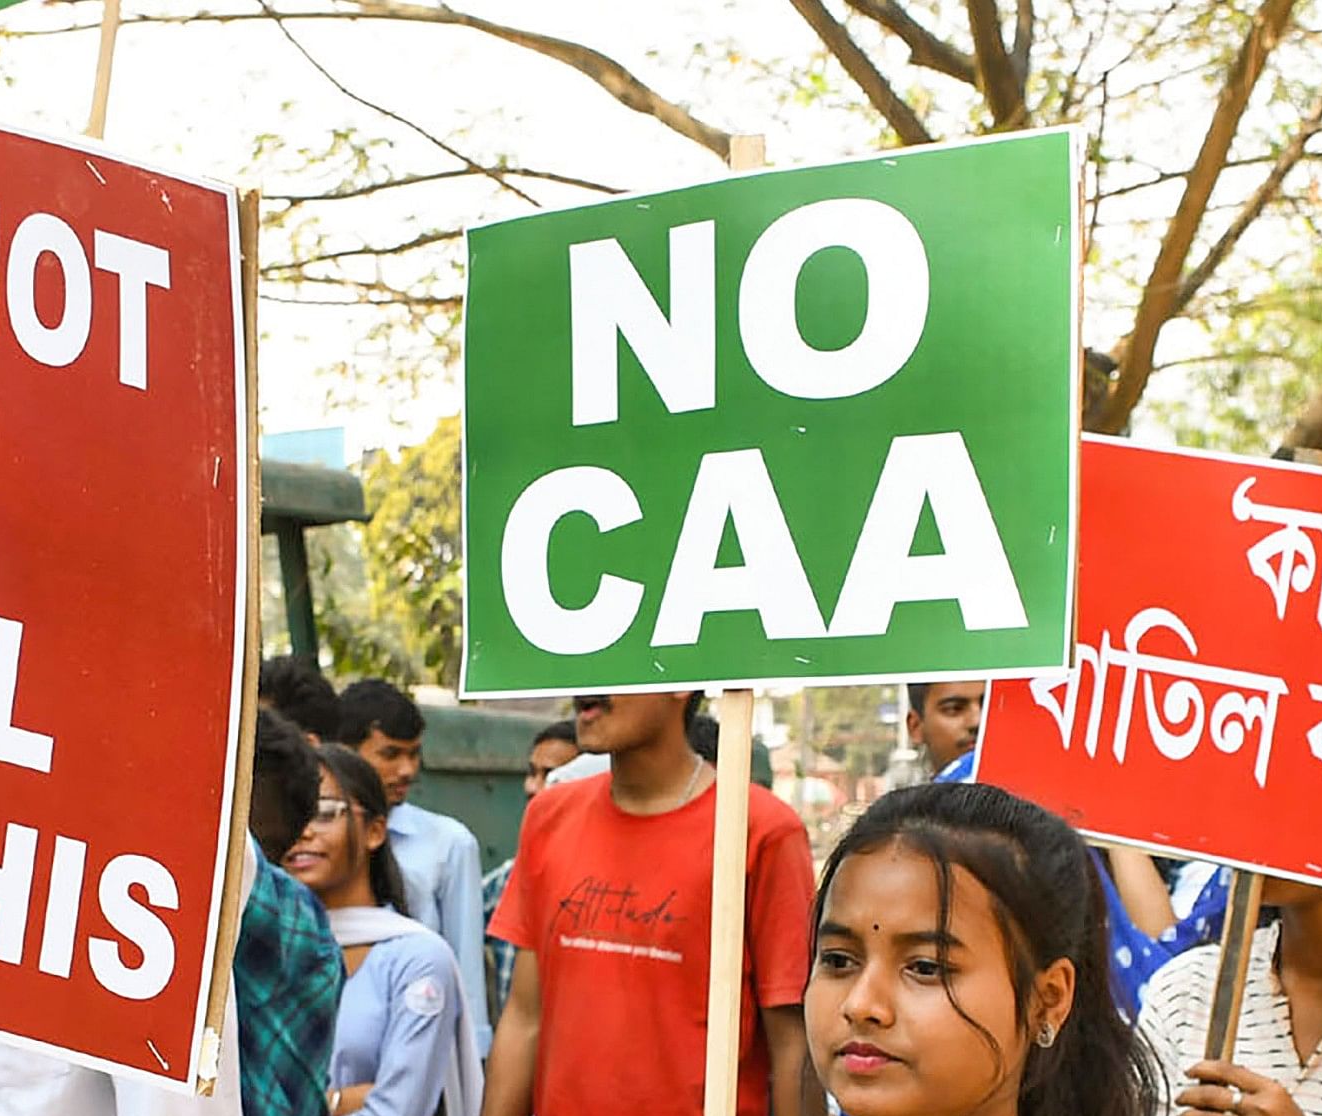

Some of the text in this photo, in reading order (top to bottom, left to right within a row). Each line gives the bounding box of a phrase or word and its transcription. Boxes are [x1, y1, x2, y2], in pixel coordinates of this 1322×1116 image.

[570, 198, 929, 425] NO
[502, 432, 1030, 654] CAA
[1029, 607, 1289, 788] বাতিল
